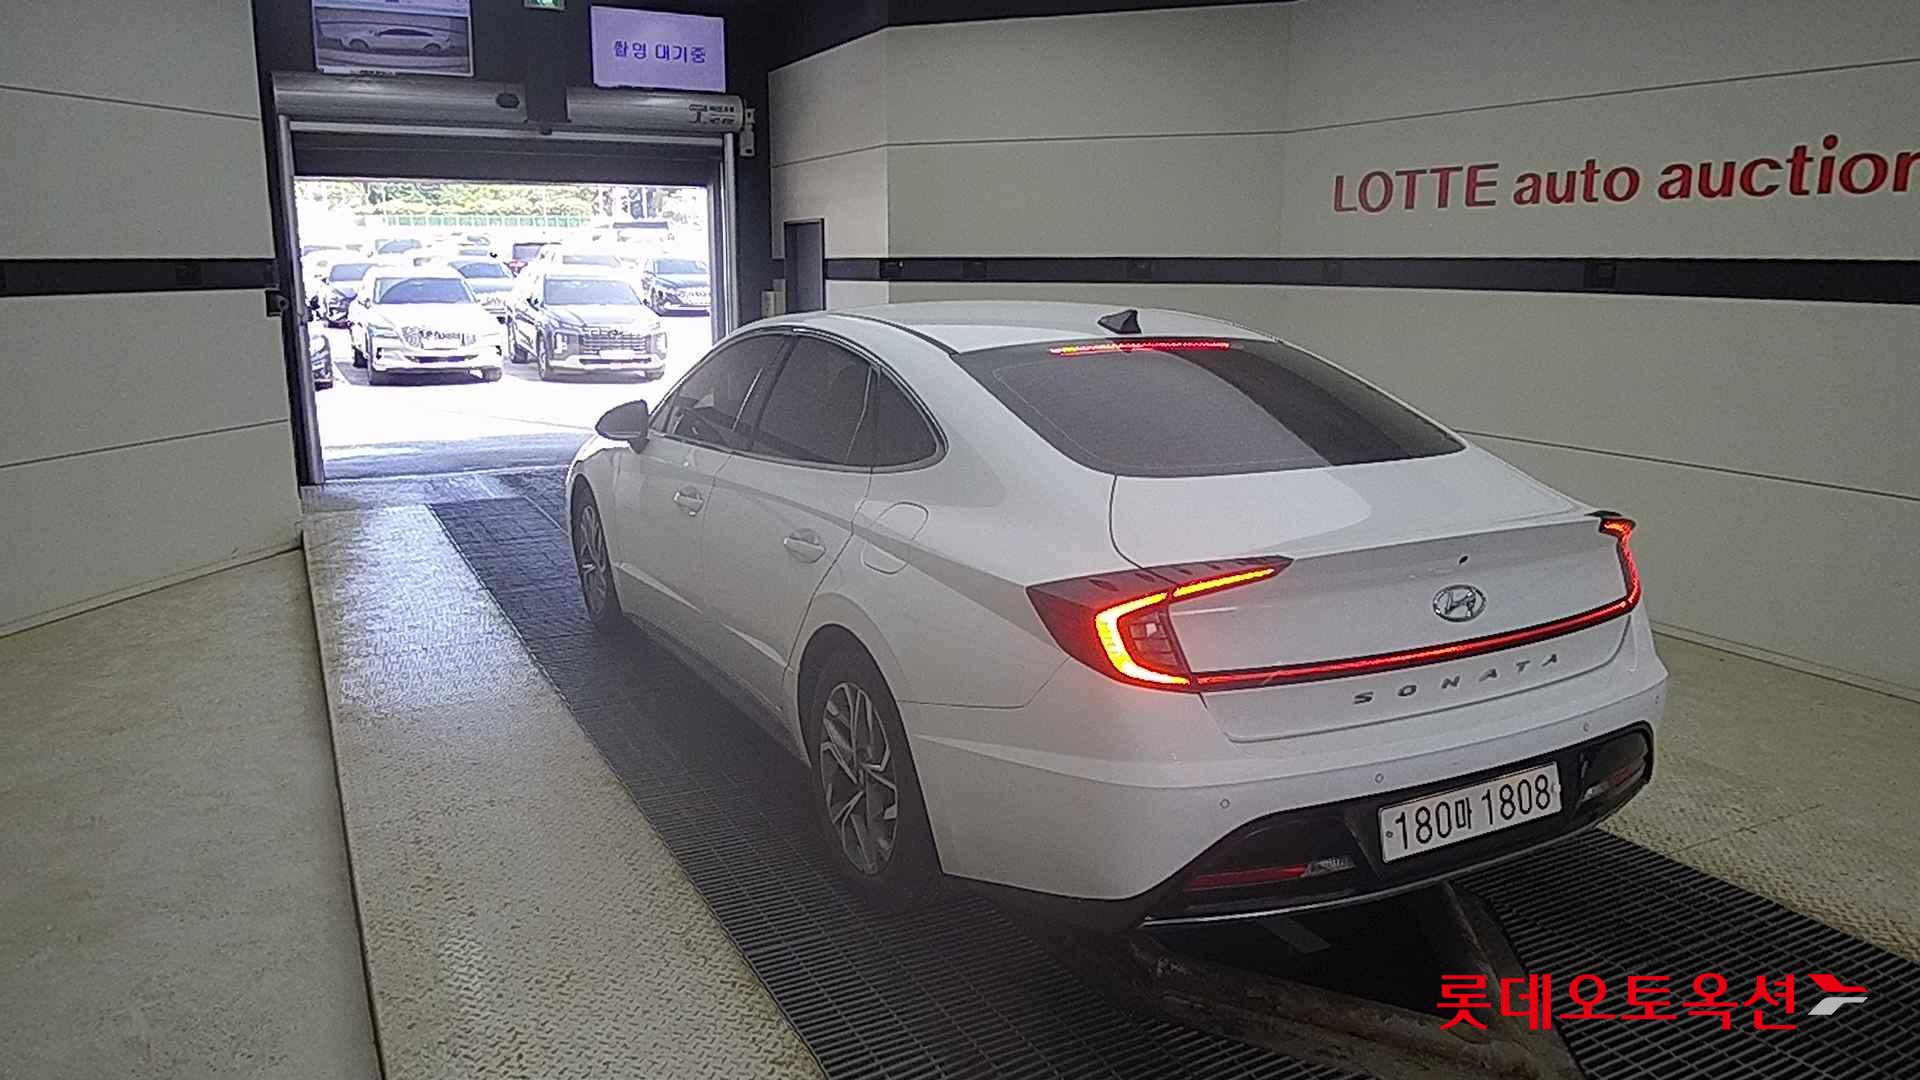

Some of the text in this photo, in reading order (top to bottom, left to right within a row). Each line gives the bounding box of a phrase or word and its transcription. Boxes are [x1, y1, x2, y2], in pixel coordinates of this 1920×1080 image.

[614, 40, 706, 64] 촬영 대기중
[1334, 163, 1499, 212] LOTTE
[1513, 160, 1640, 205] auto
[1353, 653, 1558, 705] SONATA
[1395, 774, 1551, 850] 180마 1808
